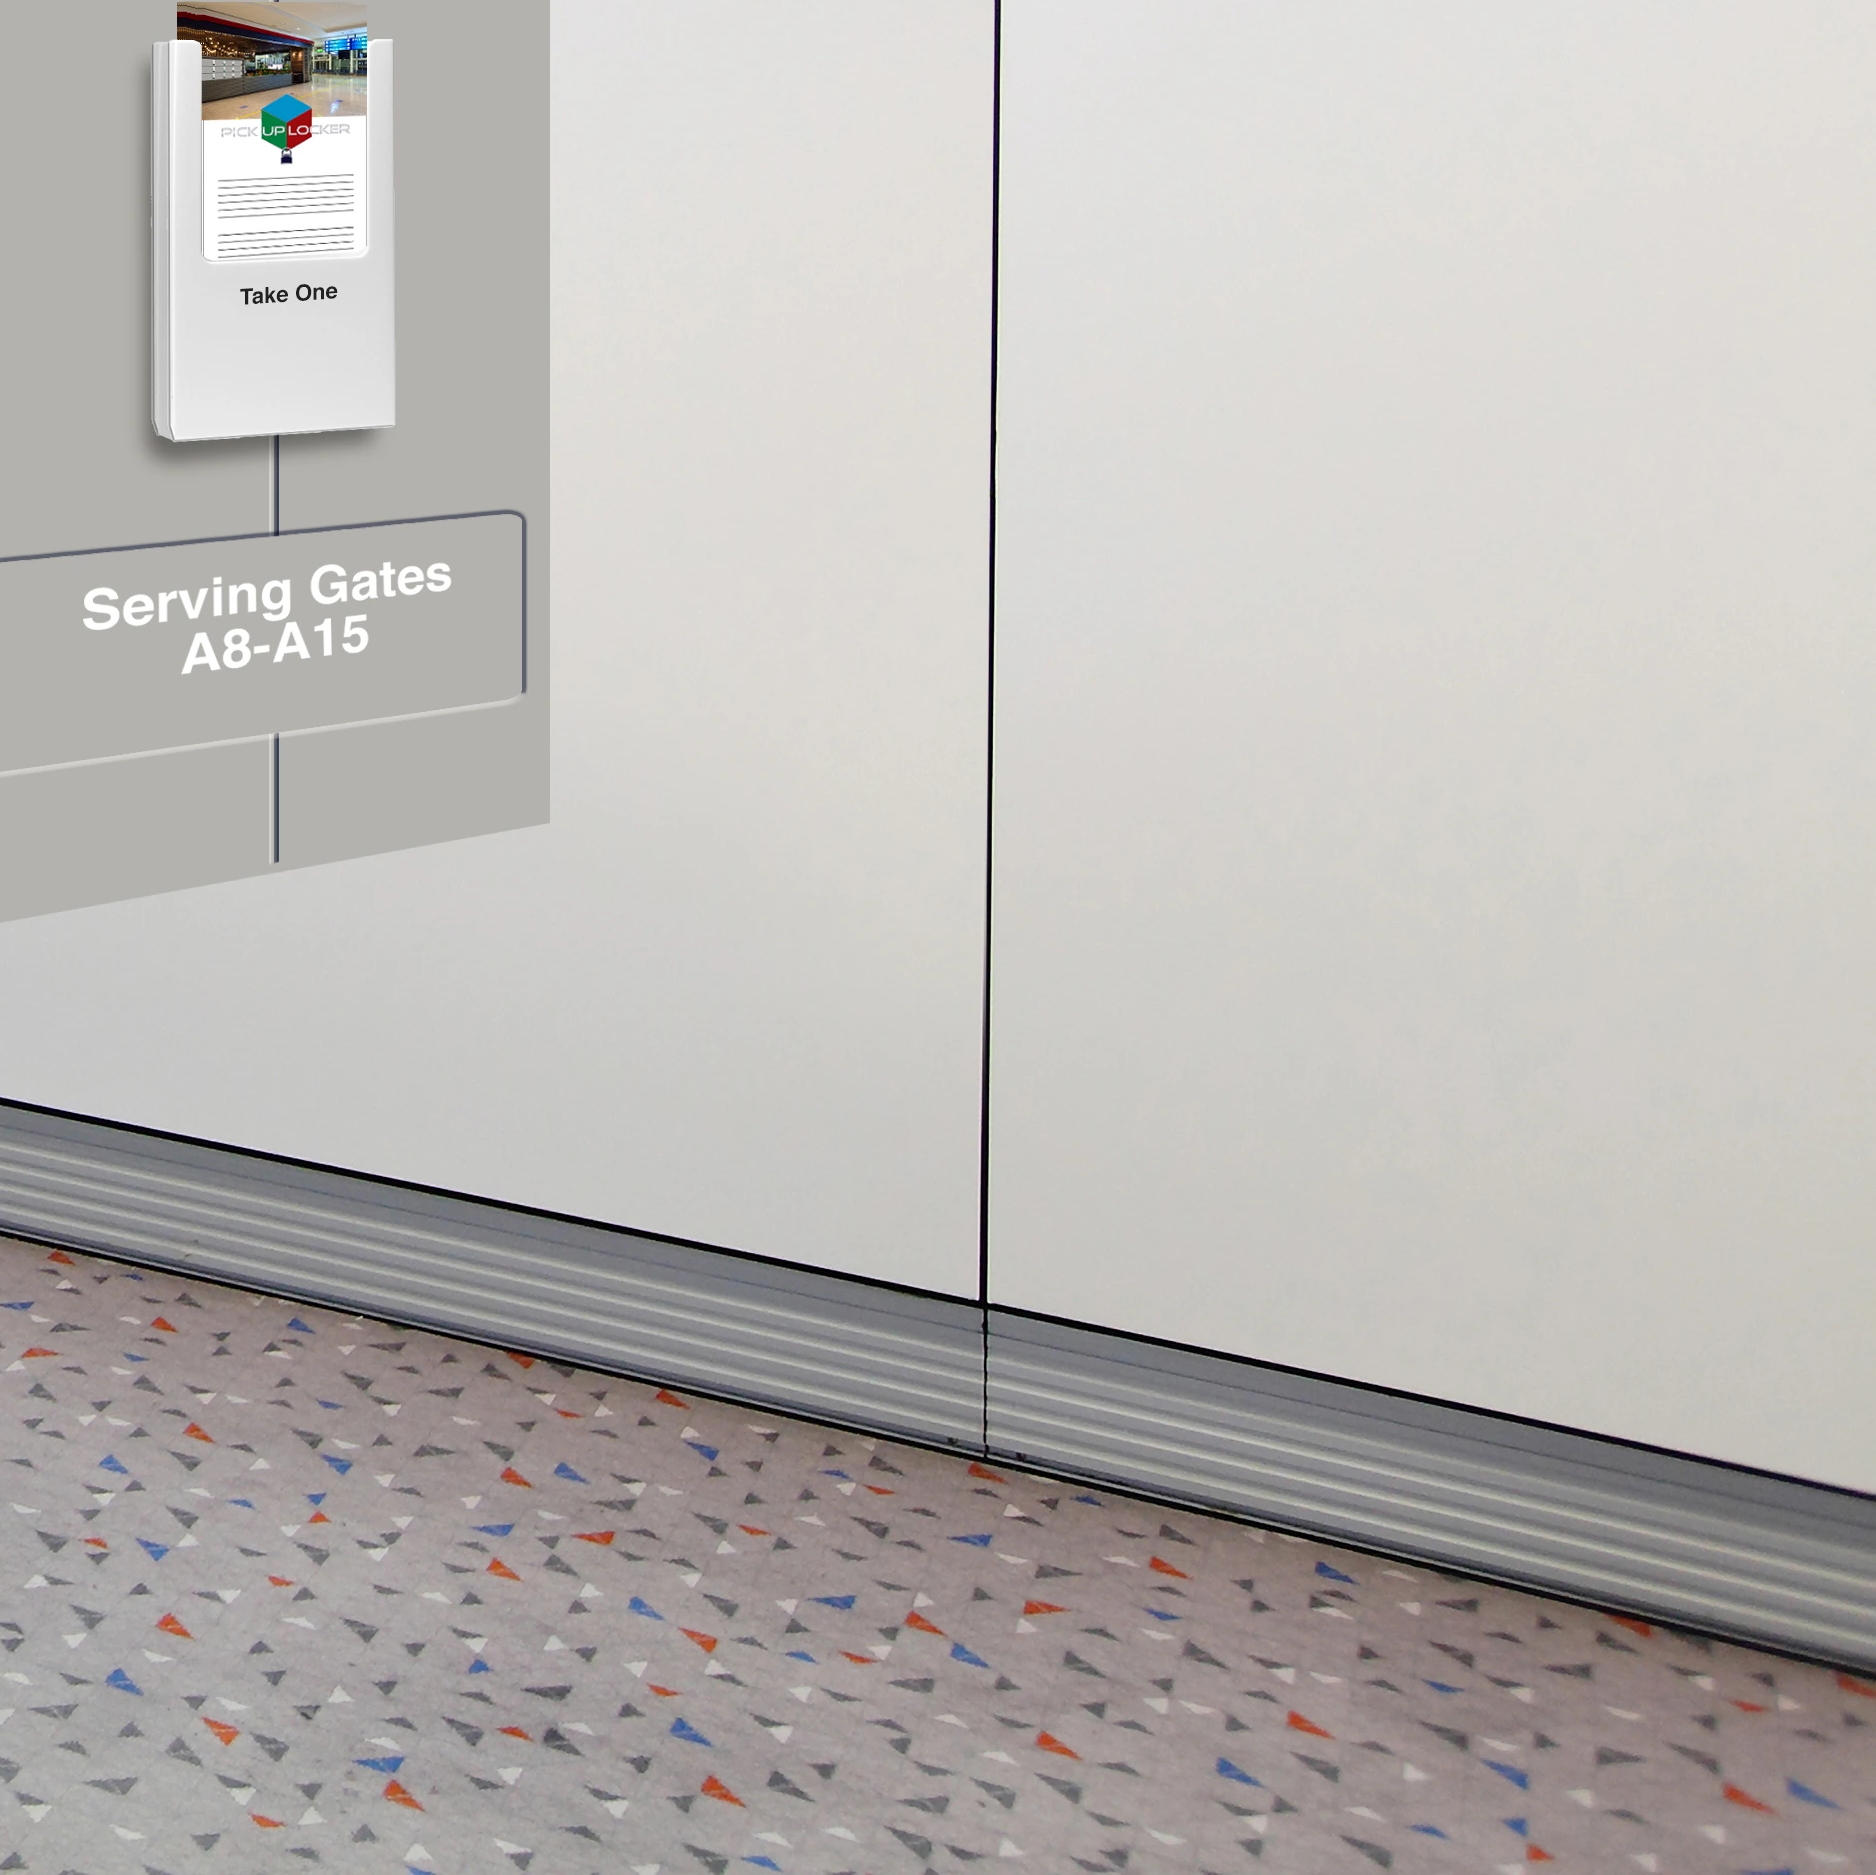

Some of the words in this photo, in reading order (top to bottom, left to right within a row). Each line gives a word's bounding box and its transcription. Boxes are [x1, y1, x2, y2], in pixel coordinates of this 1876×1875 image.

[220, 126, 259, 138] PICK
[262, 125, 286, 137] UP
[288, 123, 351, 136] LOCKER
[239, 286, 289, 305] Take
[295, 283, 338, 302] One
[83, 576, 293, 632] Serving
[311, 562, 451, 604] Gates
[181, 613, 369, 675] A8-A15
